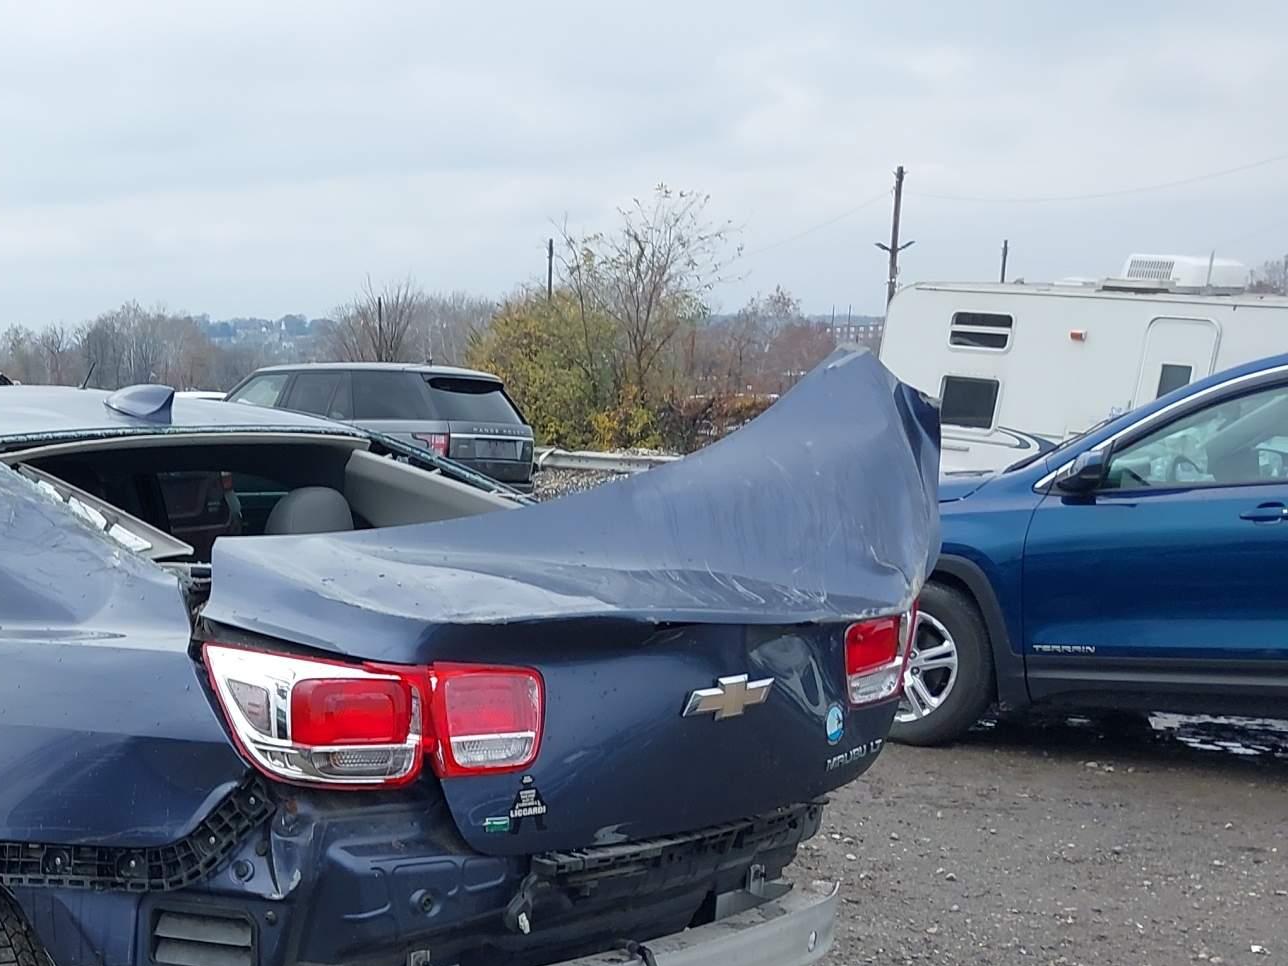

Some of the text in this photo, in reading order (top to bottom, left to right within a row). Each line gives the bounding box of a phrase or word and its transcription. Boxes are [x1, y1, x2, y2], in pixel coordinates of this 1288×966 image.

[1032, 644, 1096, 653] TERRAIN
[826, 738, 883, 771] MALIBU LT
[509, 805, 547, 818] LICCARDI
